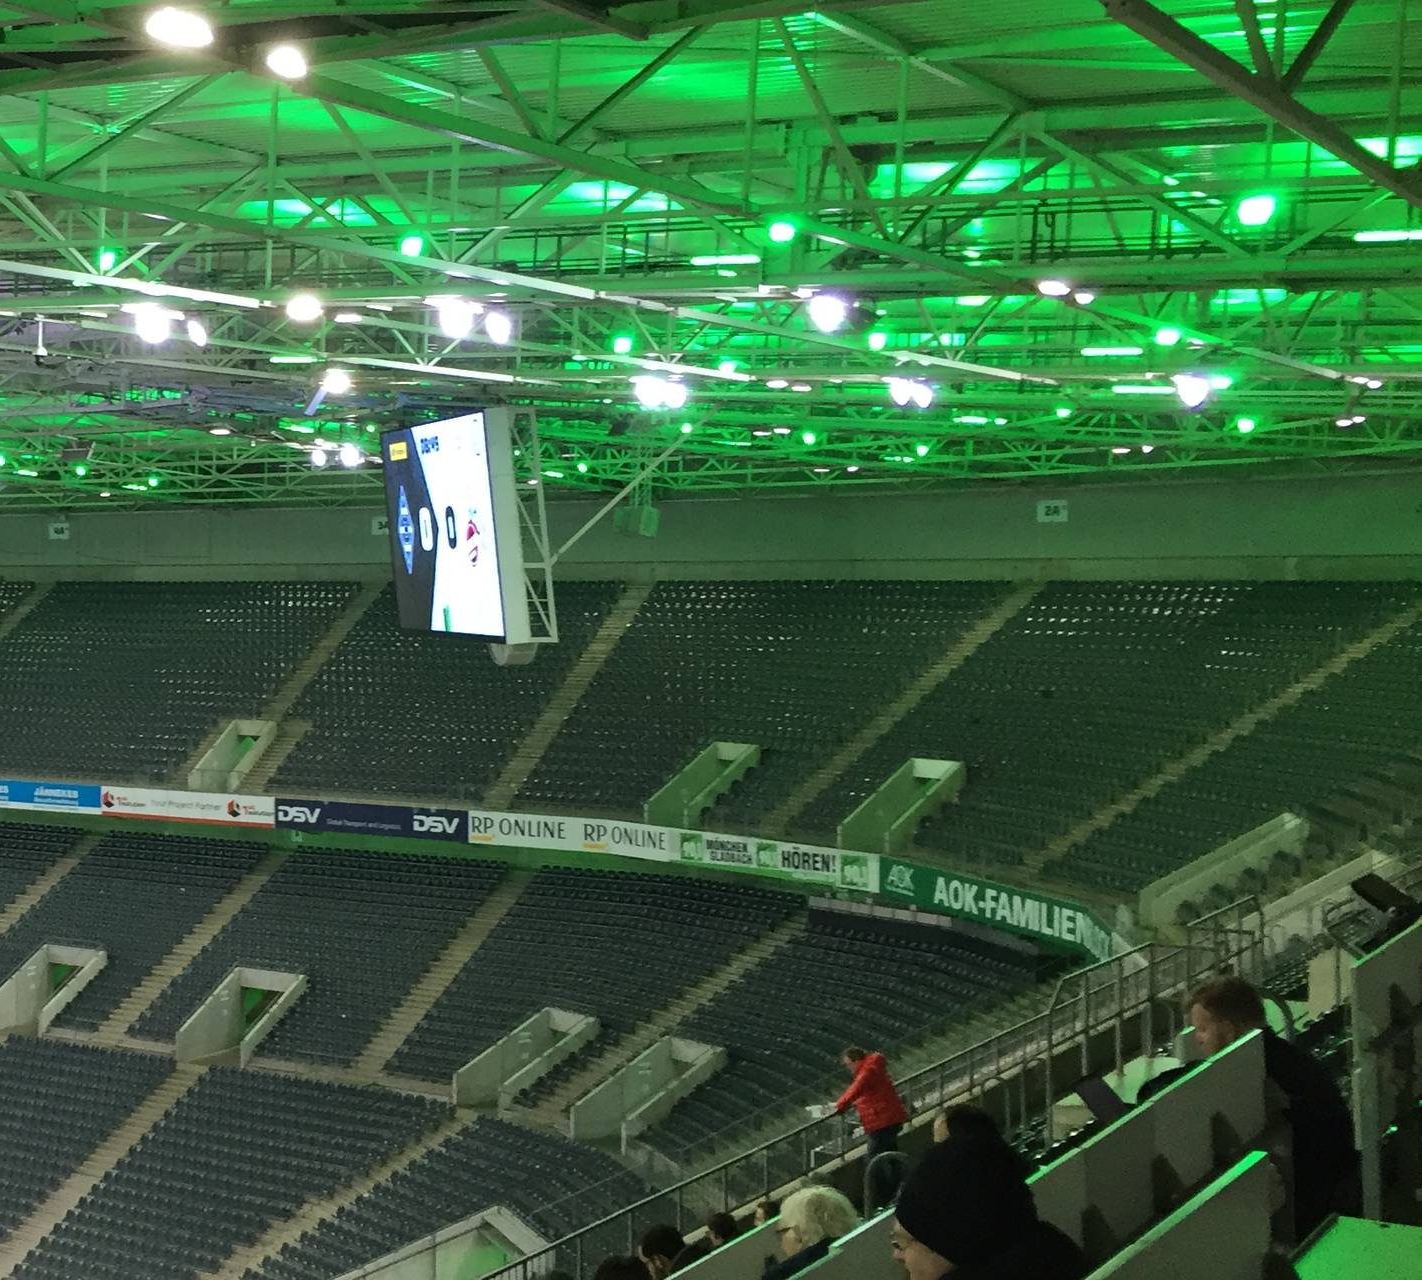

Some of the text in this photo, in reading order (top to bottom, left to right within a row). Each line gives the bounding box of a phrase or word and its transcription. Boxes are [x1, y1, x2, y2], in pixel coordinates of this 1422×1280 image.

[278, 805, 321, 824] DSV
[413, 815, 460, 834] DSV
[471, 816, 495, 833] RP
[499, 818, 567, 840] ONLINE
[583, 823, 666, 850] RP ONLINE
[706, 837, 748, 853] MÖNCHEN
[782, 846, 836, 872] HÖREN!
